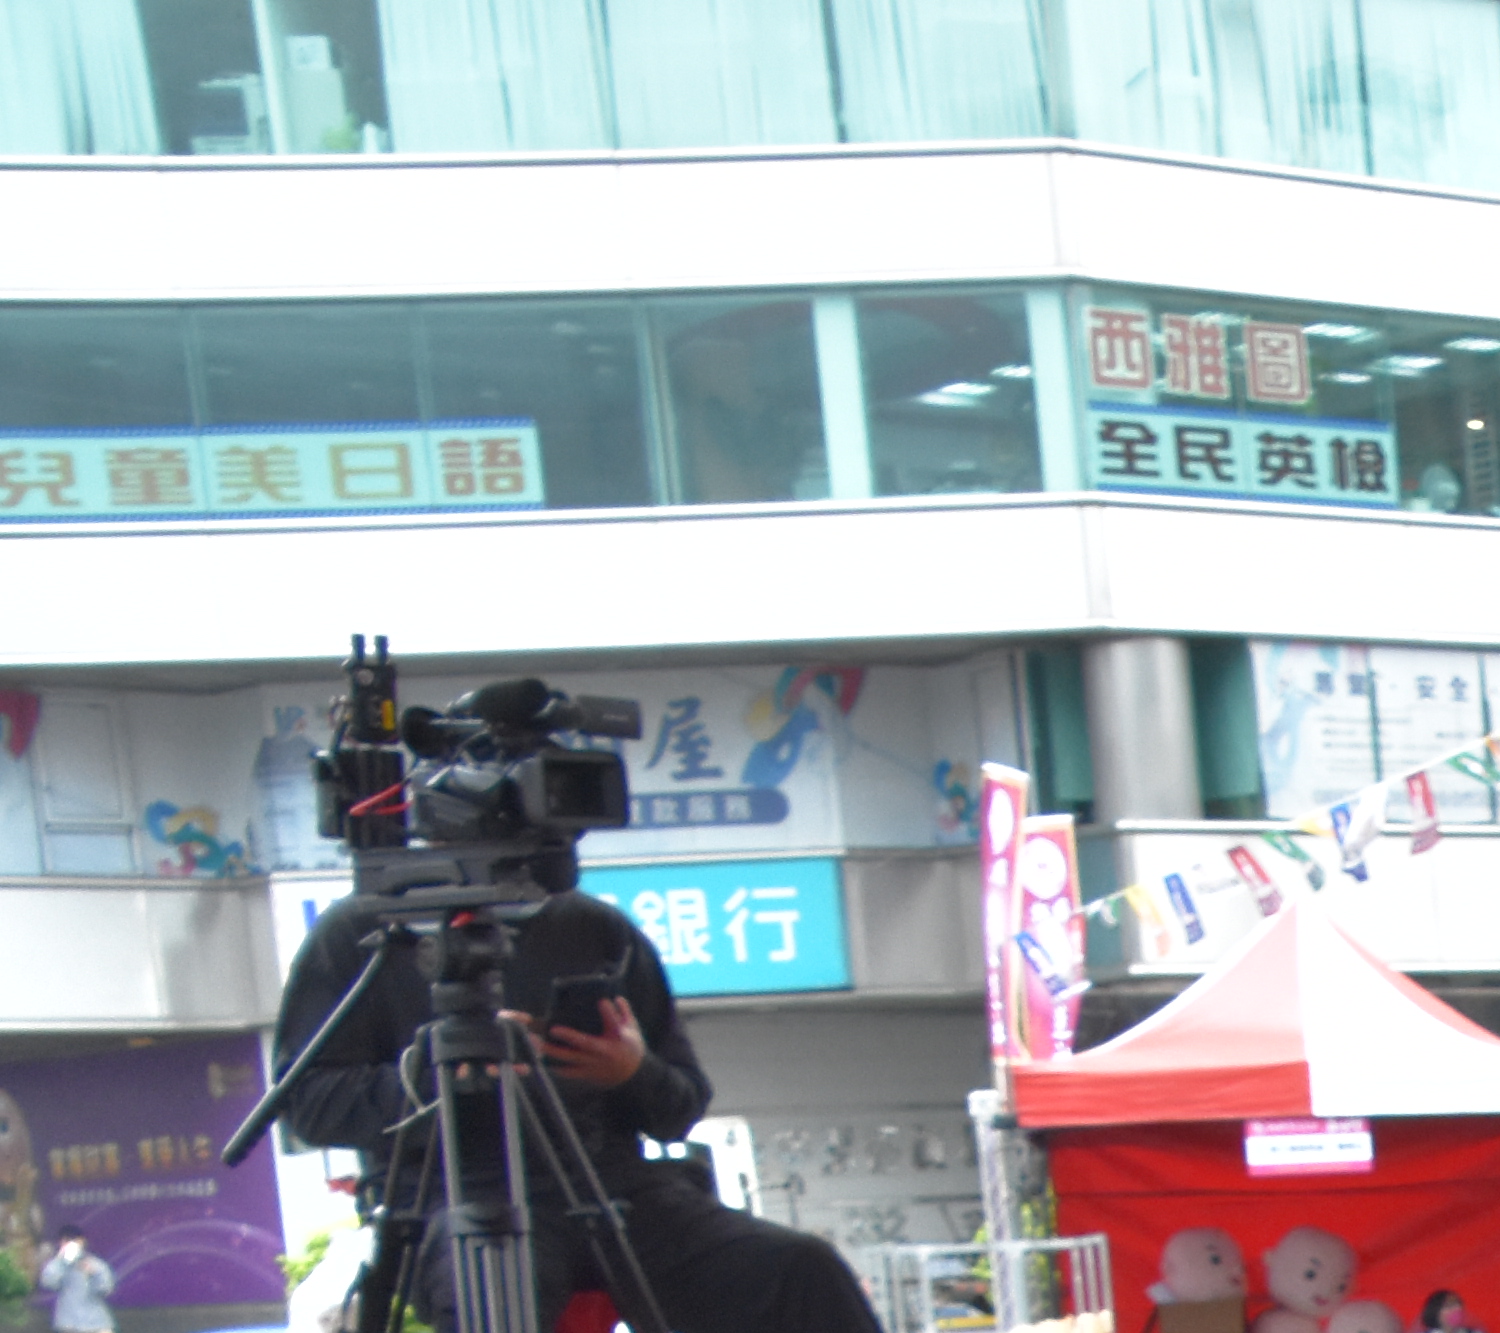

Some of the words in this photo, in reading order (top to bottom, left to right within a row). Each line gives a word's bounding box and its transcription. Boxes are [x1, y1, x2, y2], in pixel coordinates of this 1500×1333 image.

[1088, 306, 1312, 404] 西雅圖
[0, 437, 524, 507] 兒童美日語
[1098, 419, 1389, 493] 全民英檢
[612, 887, 800, 965] 銀行
